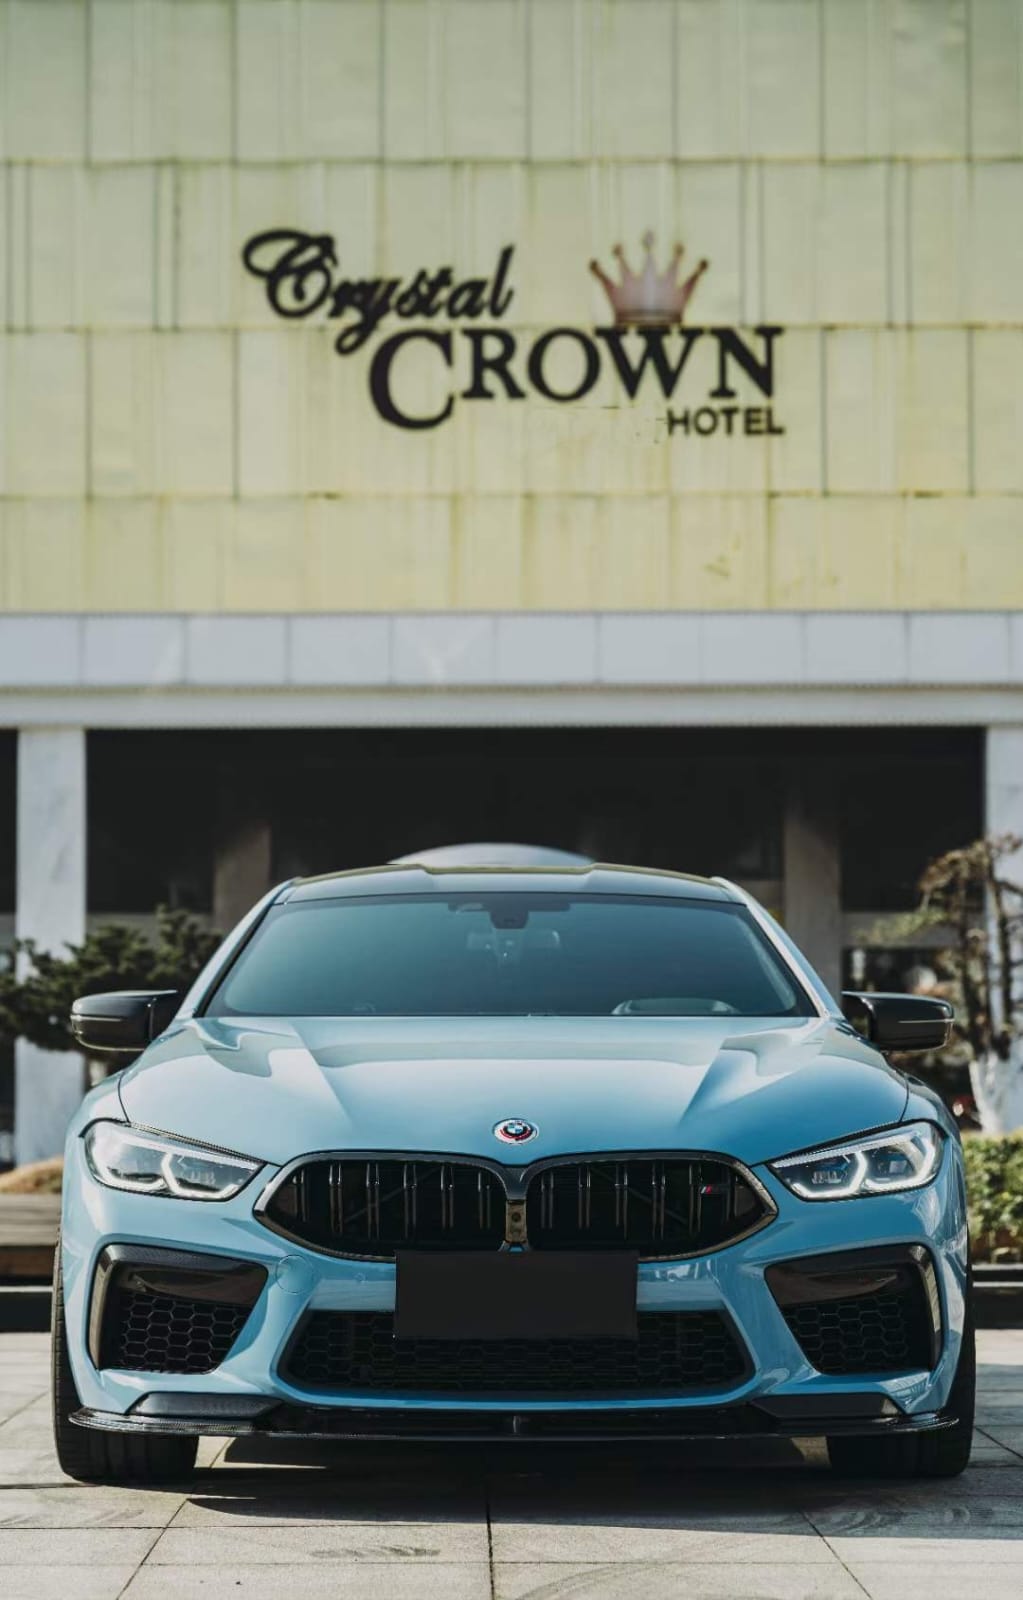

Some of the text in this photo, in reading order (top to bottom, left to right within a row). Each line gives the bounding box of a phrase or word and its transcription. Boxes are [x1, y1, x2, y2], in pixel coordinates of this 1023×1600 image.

[242, 228, 515, 355] Crystal
[368, 326, 784, 430] CROWN
[666, 408, 785, 436] HOTEL
